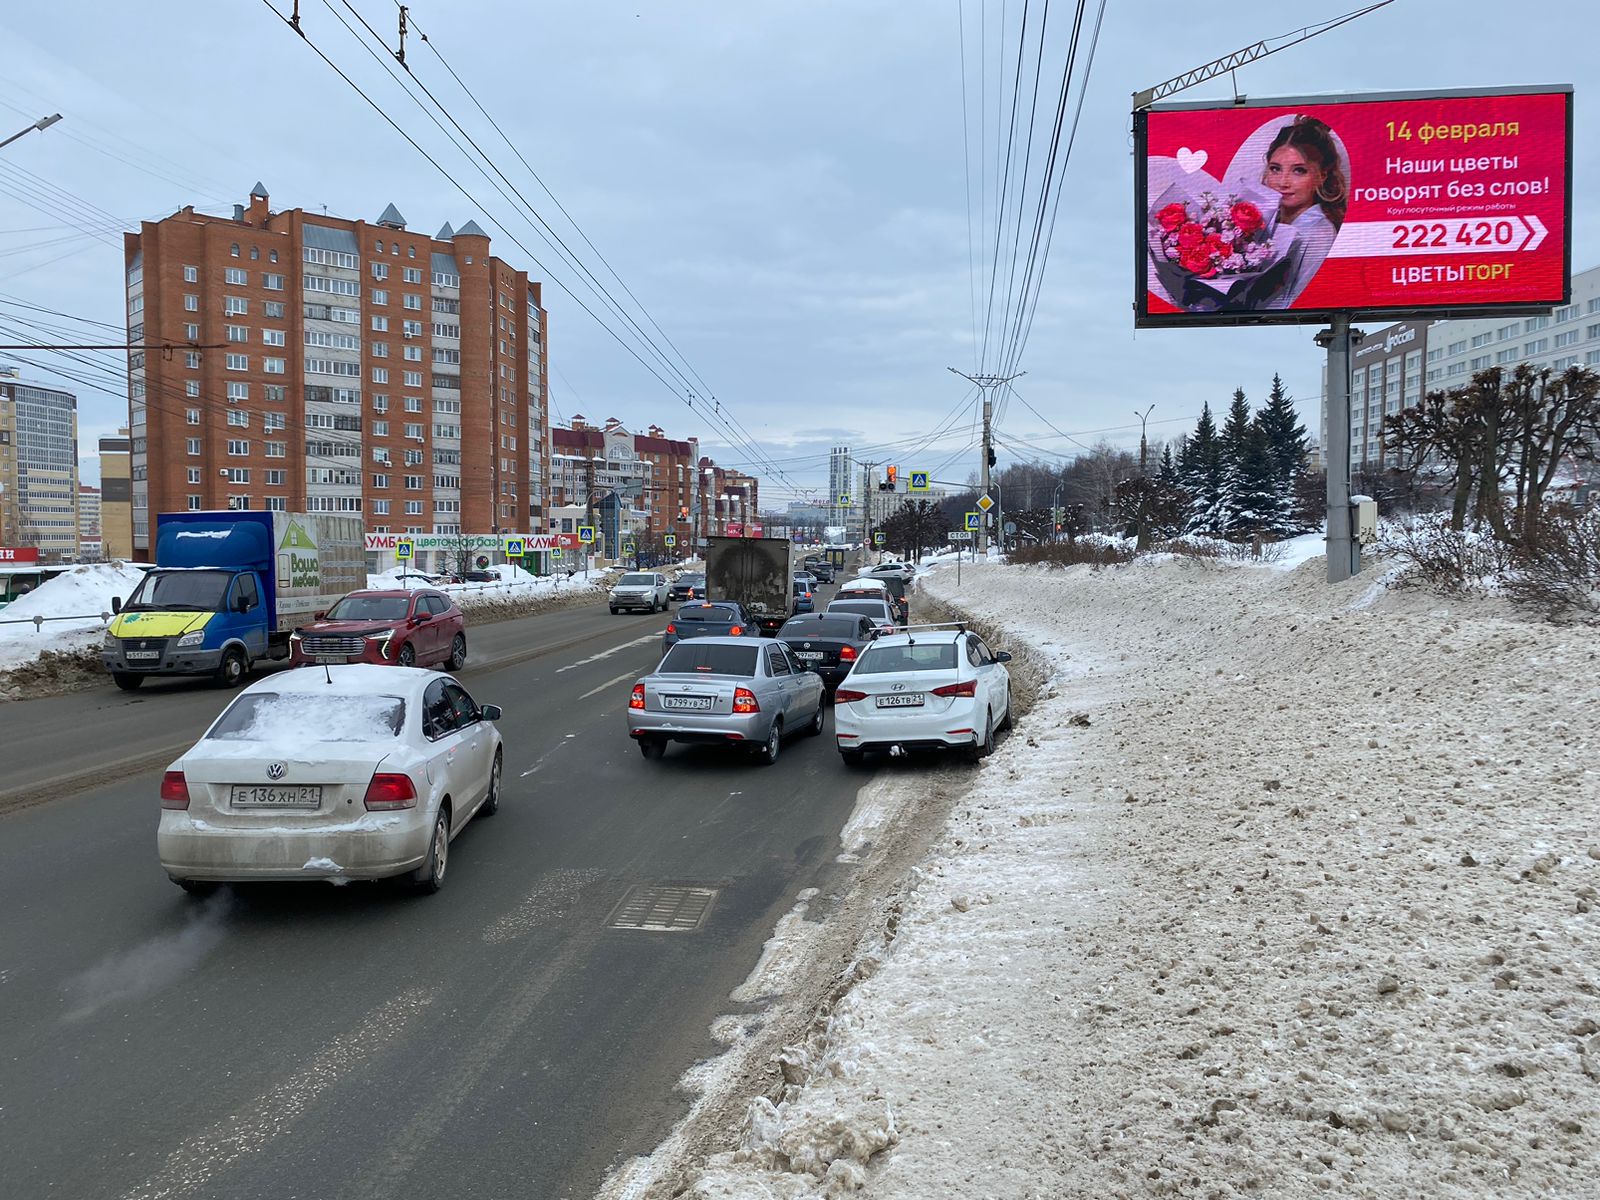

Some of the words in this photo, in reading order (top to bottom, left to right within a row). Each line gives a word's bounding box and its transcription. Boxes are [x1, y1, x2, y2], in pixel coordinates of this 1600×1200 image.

[1385, 120, 1412, 142] 14
[1417, 121, 1520, 144] февраля
[1385, 157, 1445, 174] Наши
[1450, 155, 1518, 174] цветы
[1354, 185, 1443, 204] говорят
[1447, 180, 1484, 198] без
[1489, 177, 1549, 197] слов!
[1387, 205, 1455, 216] Круглосуточный
[1456, 204, 1484, 213] режим
[1485, 203, 1516, 211] работы
[1392, 223, 1447, 248] 222
[1455, 221, 1513, 246] 420
[477, 538, 503, 547] база
[291, 553, 319, 572] Ваша
[292, 573, 320, 588] мебель
[300, 788, 315, 799] 21
